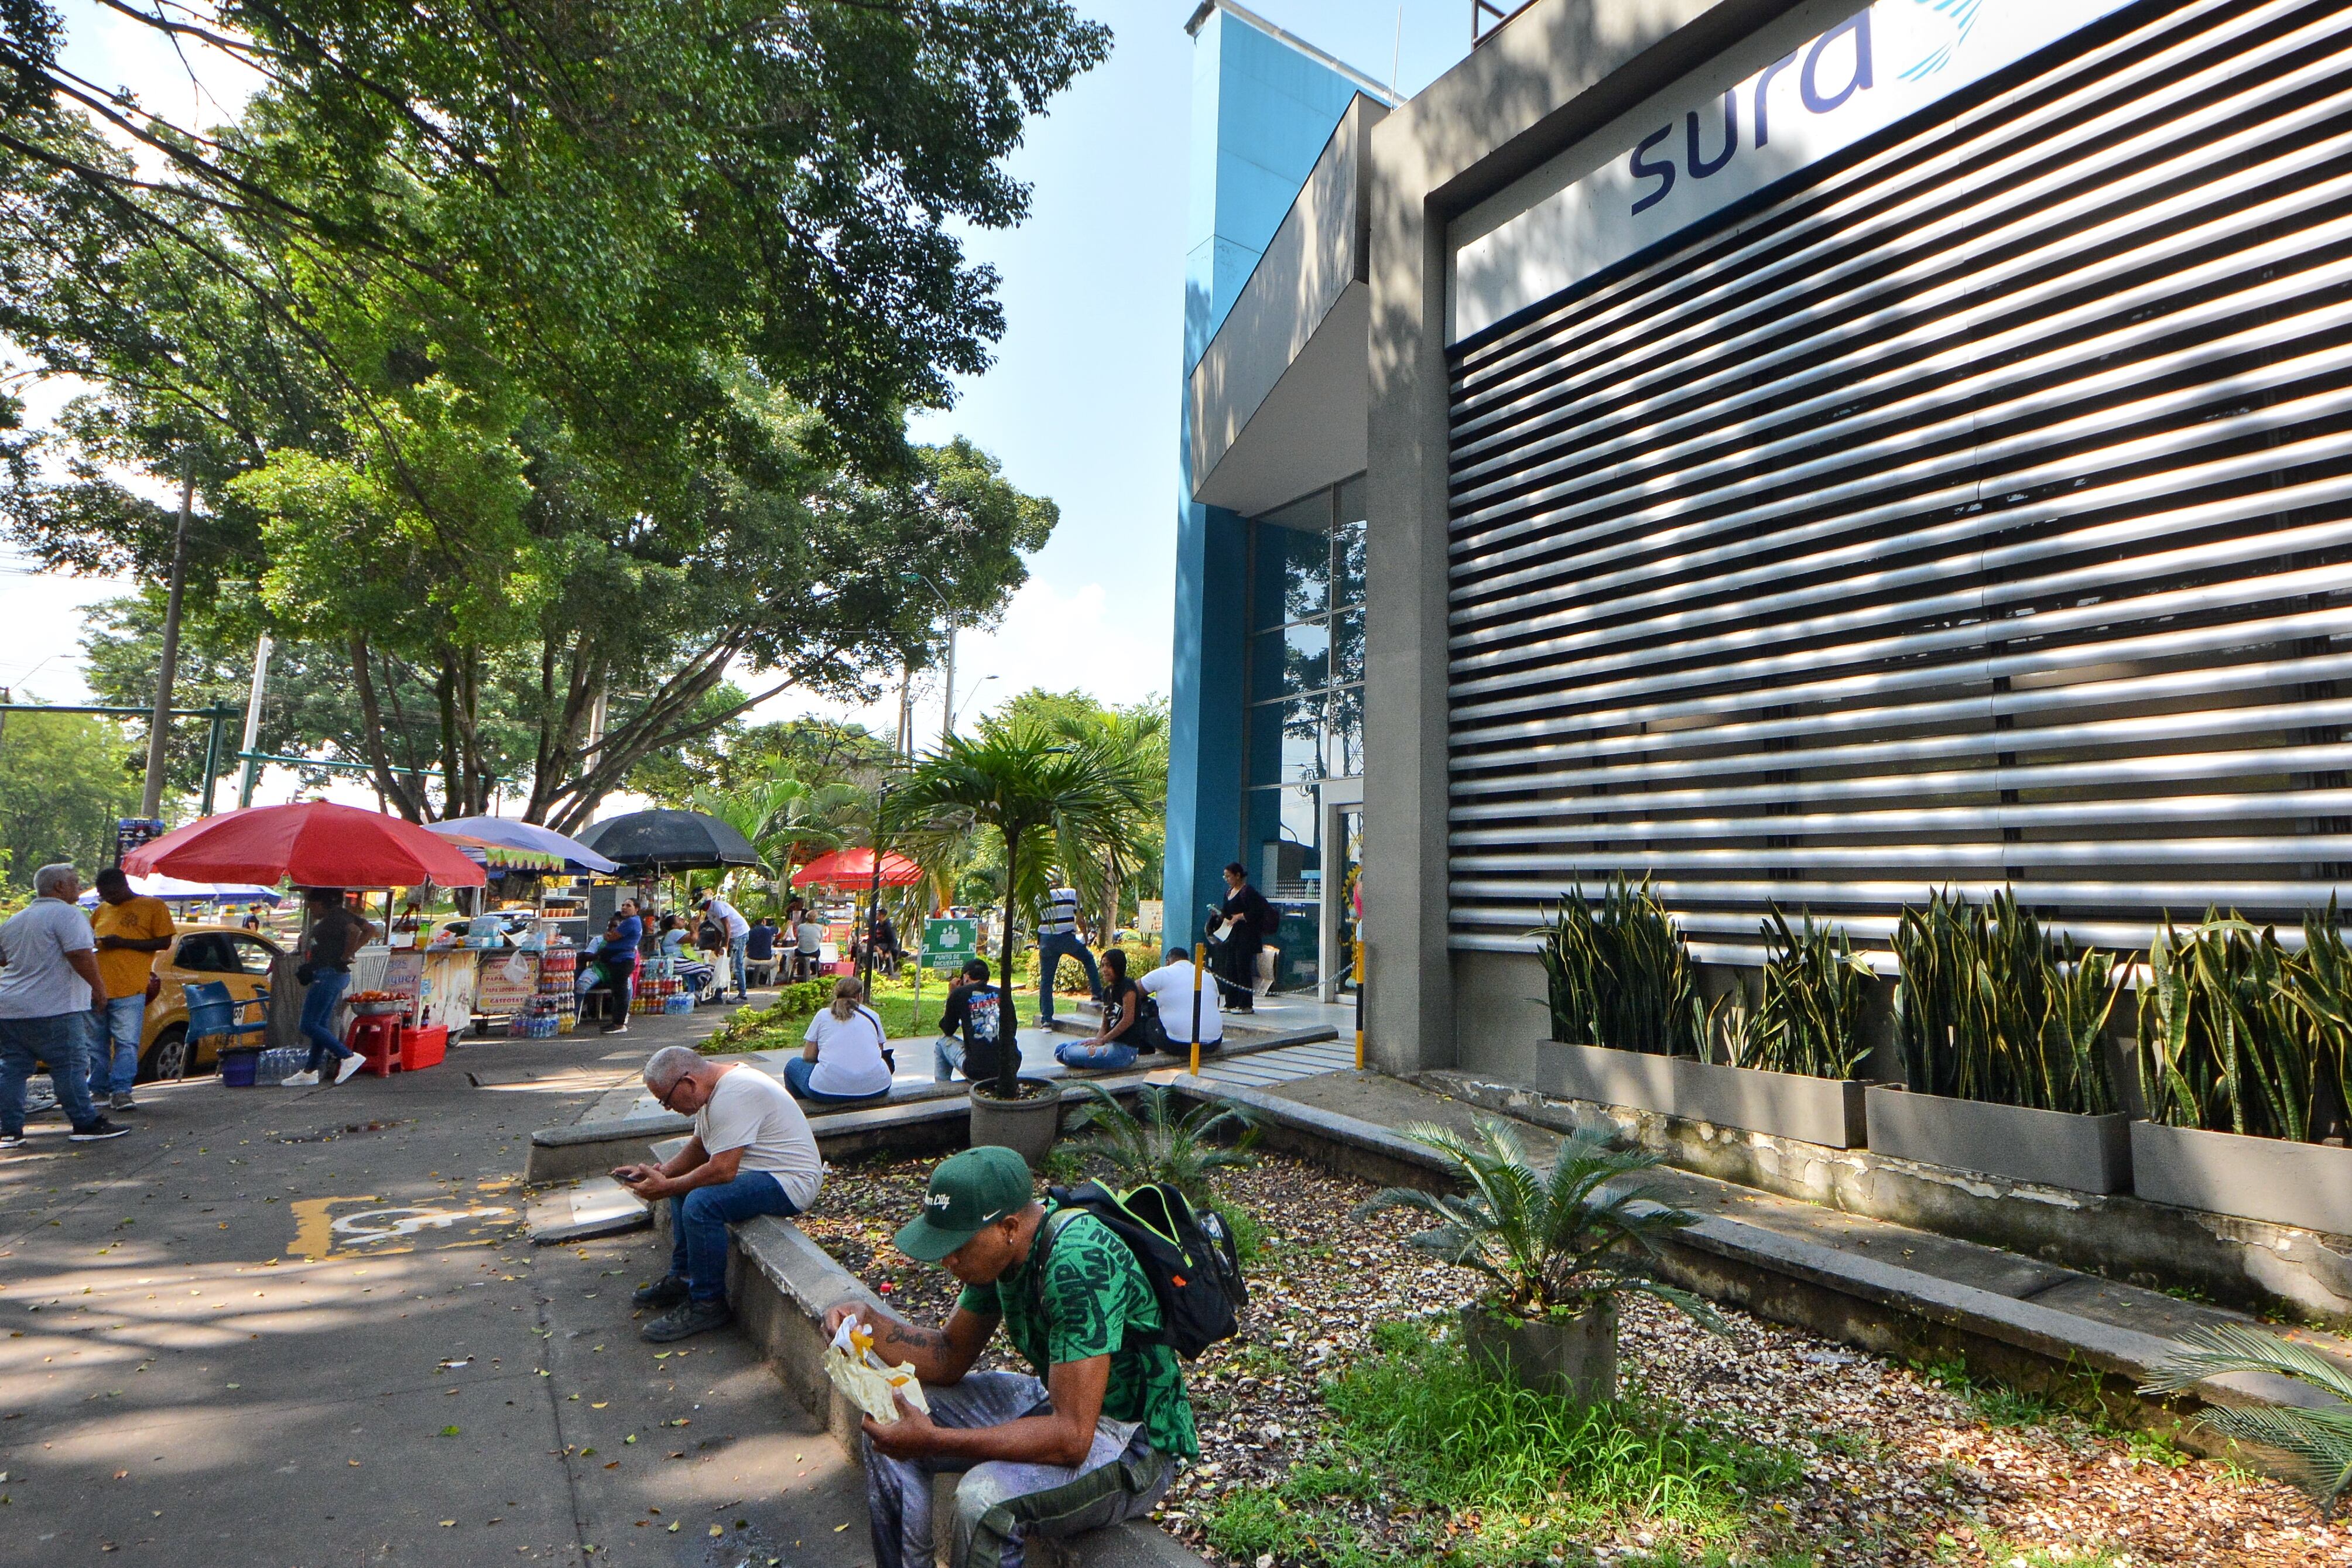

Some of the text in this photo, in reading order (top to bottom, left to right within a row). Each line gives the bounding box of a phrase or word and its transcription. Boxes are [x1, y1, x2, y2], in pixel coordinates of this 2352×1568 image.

[1629, 6, 1874, 217] sura
[933, 1194, 950, 1210] City
[1055, 1264, 1089, 1339] JUMP
